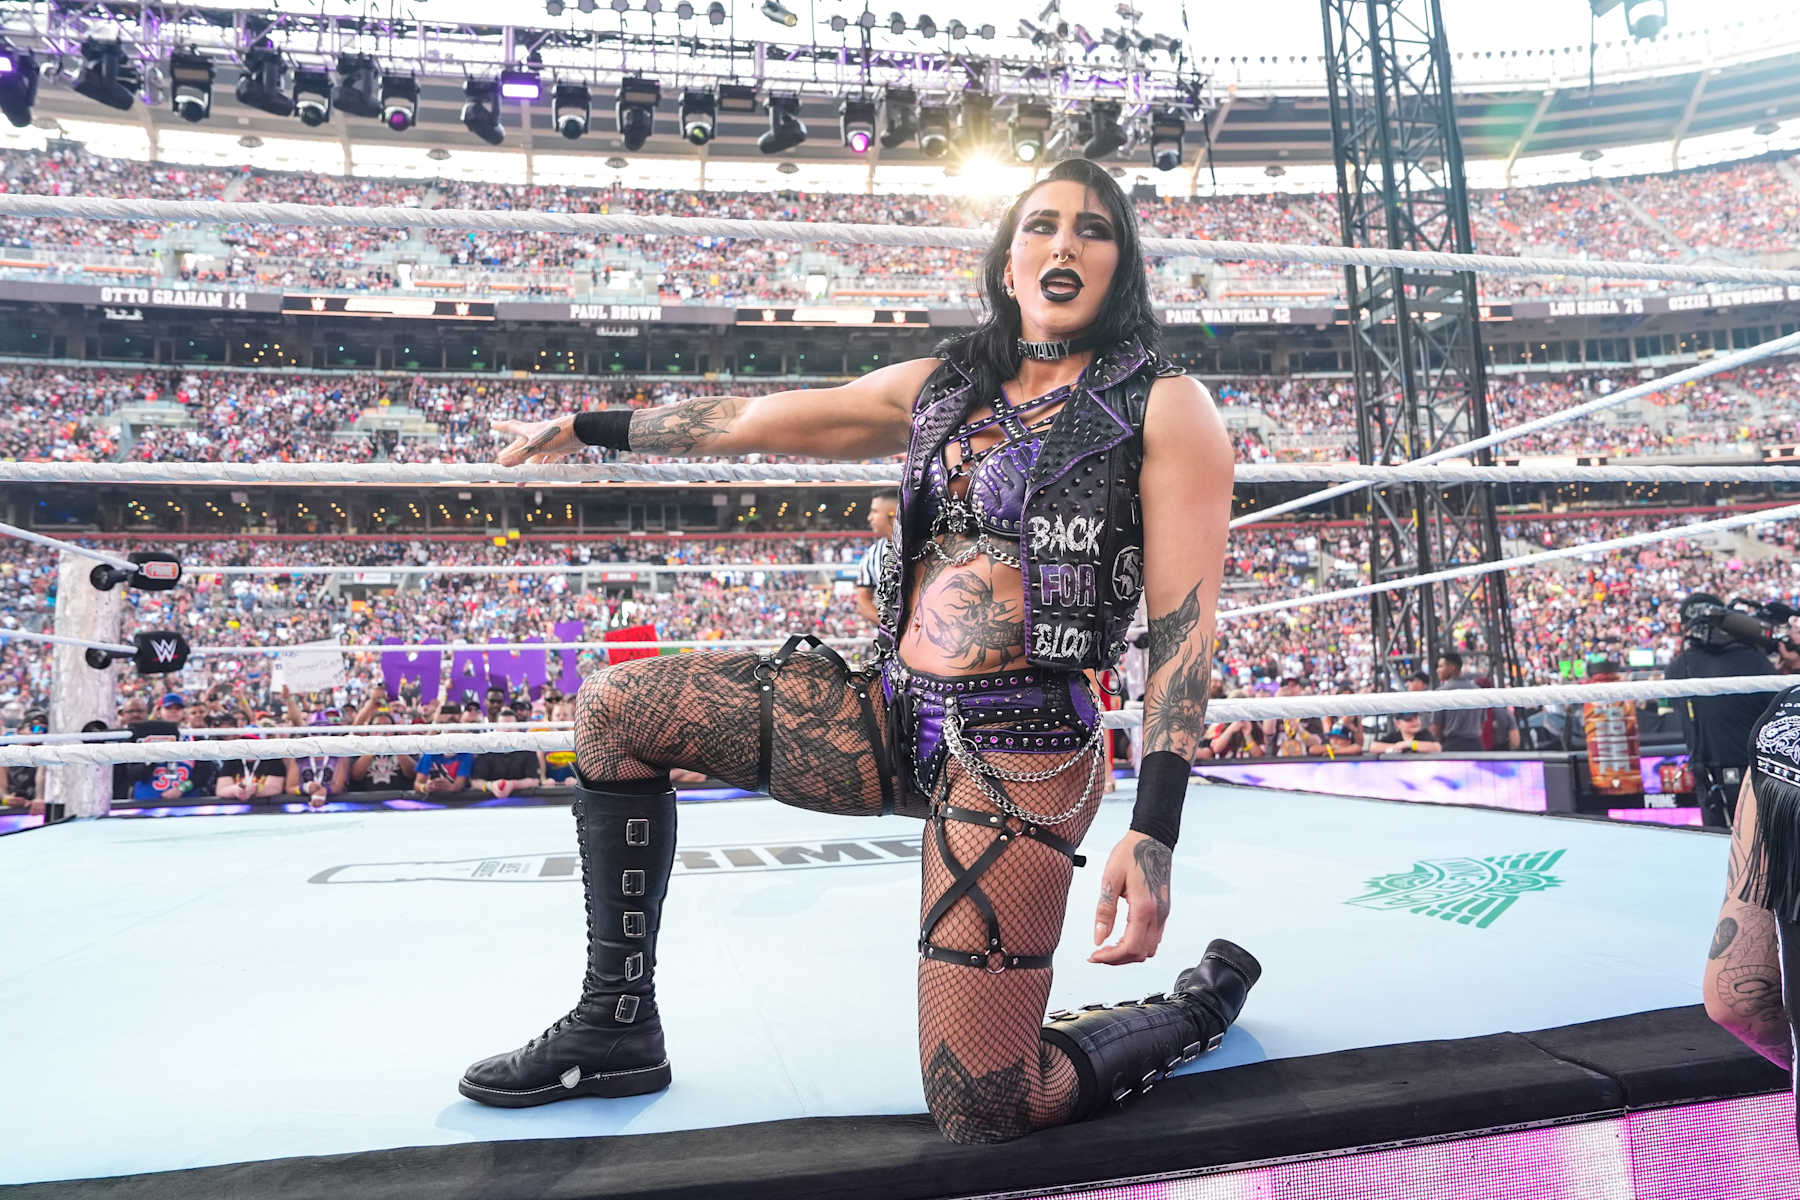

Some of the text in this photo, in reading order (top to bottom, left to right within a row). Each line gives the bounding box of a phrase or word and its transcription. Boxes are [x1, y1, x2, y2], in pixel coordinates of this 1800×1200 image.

[101, 287, 247, 309] OTTO GRAHAM 14
[570, 304, 662, 321] PAUL BROWN
[1549, 301, 1577, 316] LOU
[1165, 307, 1291, 324] PAUL WARFIELD 42
[1028, 514, 1105, 557] BACK
[1039, 564, 1095, 607] FOR
[1034, 623, 1102, 662] BLOOD
[381, 621, 585, 718] MAMI
